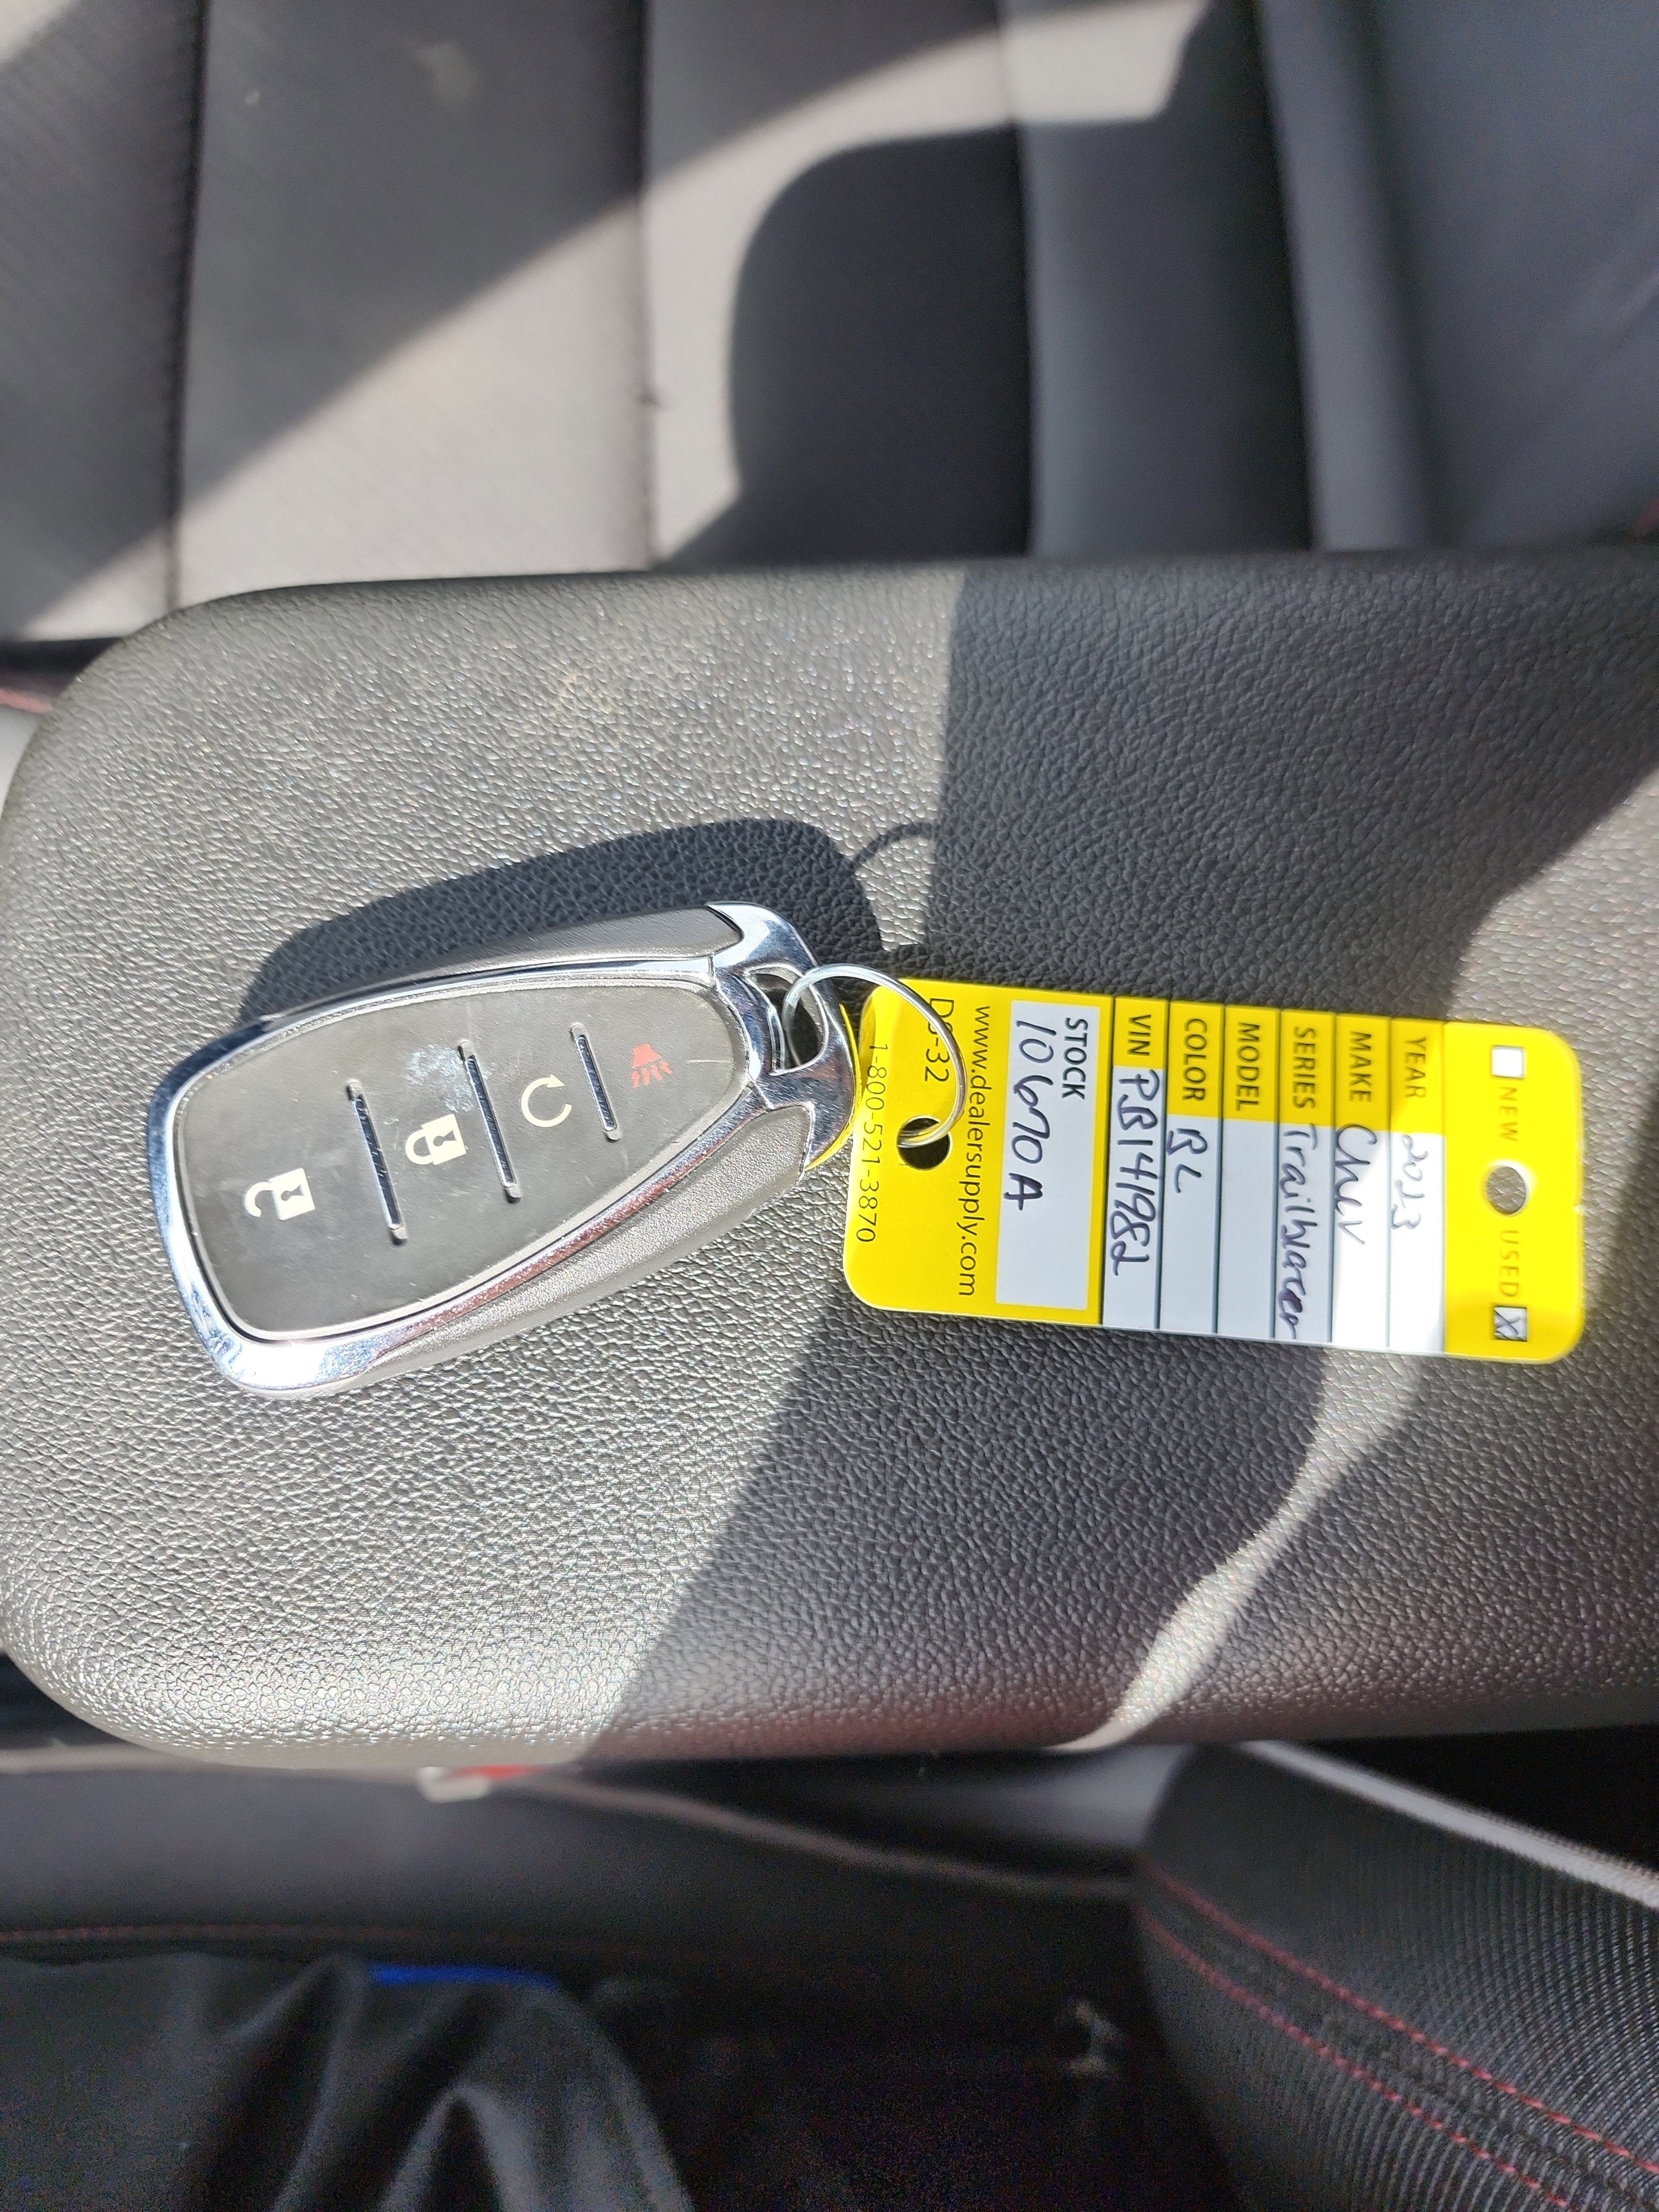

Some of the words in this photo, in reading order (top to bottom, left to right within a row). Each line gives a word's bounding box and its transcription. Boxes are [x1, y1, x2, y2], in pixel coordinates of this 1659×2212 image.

[1061, 1017, 1088, 1100] STOCK
[1126, 1014, 1151, 1057] VIN
[1181, 1017, 1208, 1102] COLOR
[1234, 1021, 1260, 1112] MODEL
[1291, 1026, 1317, 1109] SERIES
[1348, 1030, 1373, 1103] MAKE
[1403, 1036, 1427, 1098] YEAR
[855, 1042, 888, 1244] 1-800-521-3870
[957, 1005, 992, 1297] www.dealersupply.com
[1496, 1084, 1520, 1142] NEW
[1498, 1228, 1522, 1298] USED
